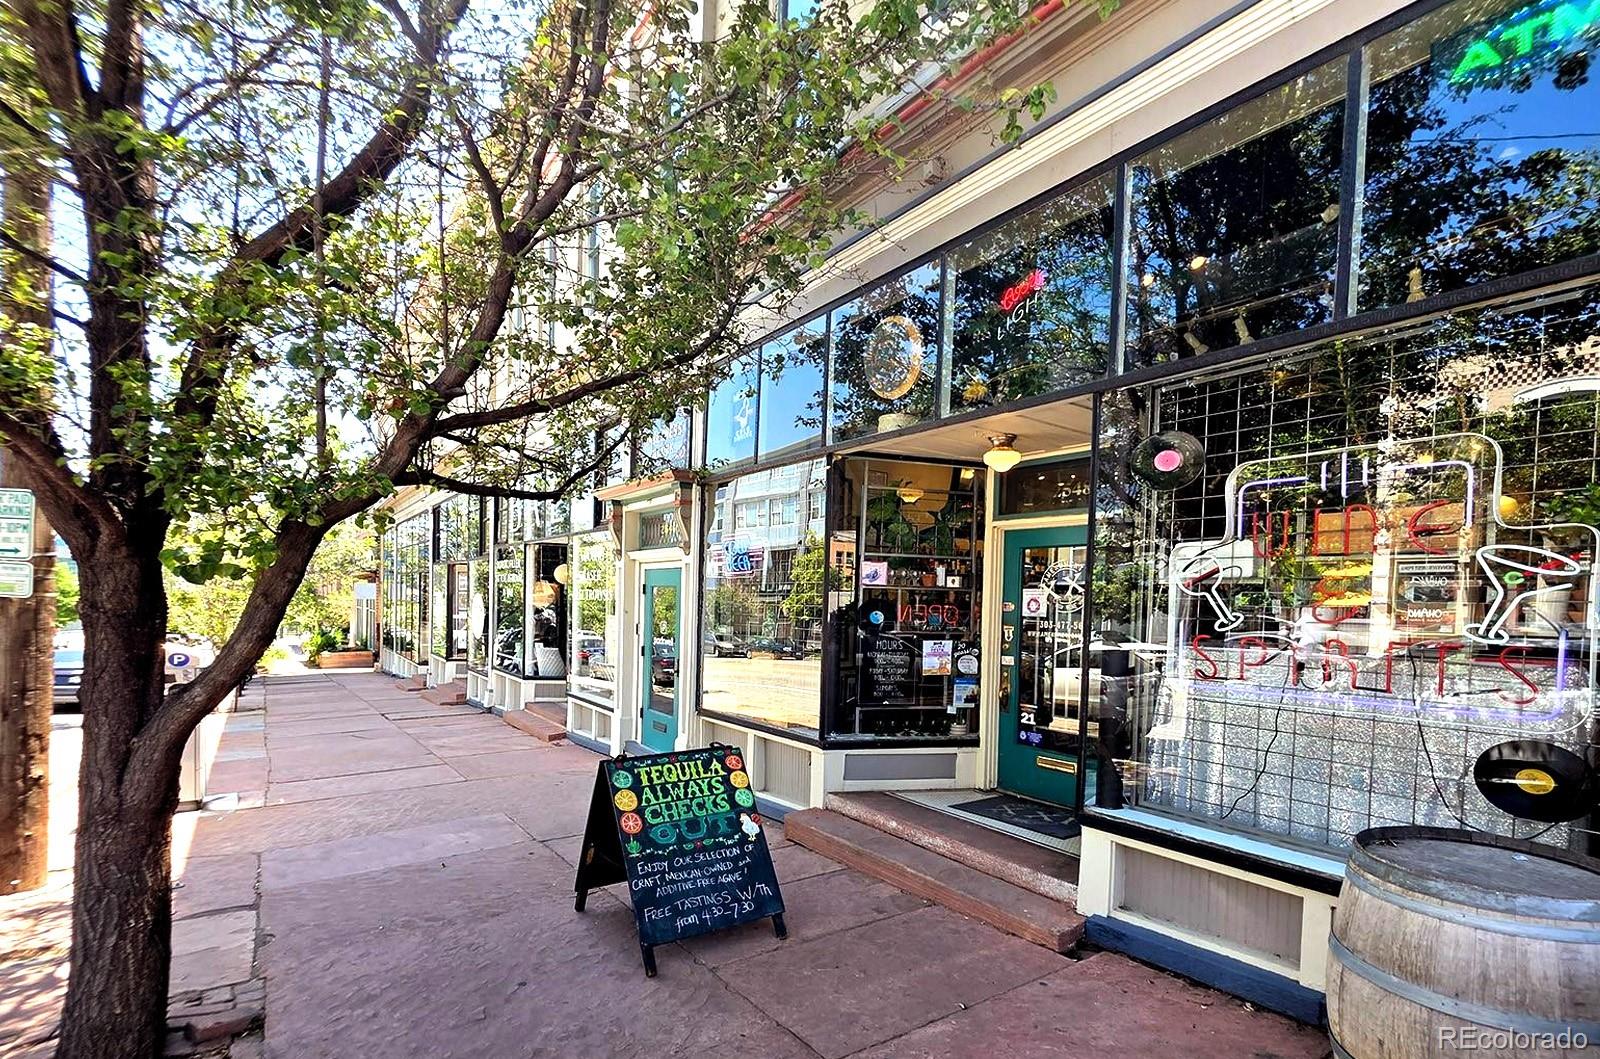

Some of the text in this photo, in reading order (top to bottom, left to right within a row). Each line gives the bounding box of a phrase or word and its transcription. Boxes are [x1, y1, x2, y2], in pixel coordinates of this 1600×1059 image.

[875, 639, 904, 650] HOURS
[173, 654, 186, 665] P
[1020, 712, 1036, 725] 21
[634, 758, 728, 787] TEQUILA
[641, 776, 725, 806] ALWAYS
[644, 793, 731, 825] CHECKS
[649, 811, 737, 844] OUT
[637, 843, 755, 875] ENJOY OUR SELECTION OF
[738, 856, 752, 867] and
[644, 905, 673, 922] FREE
[674, 890, 732, 911] TASTINGS
[675, 914, 700, 933] from
